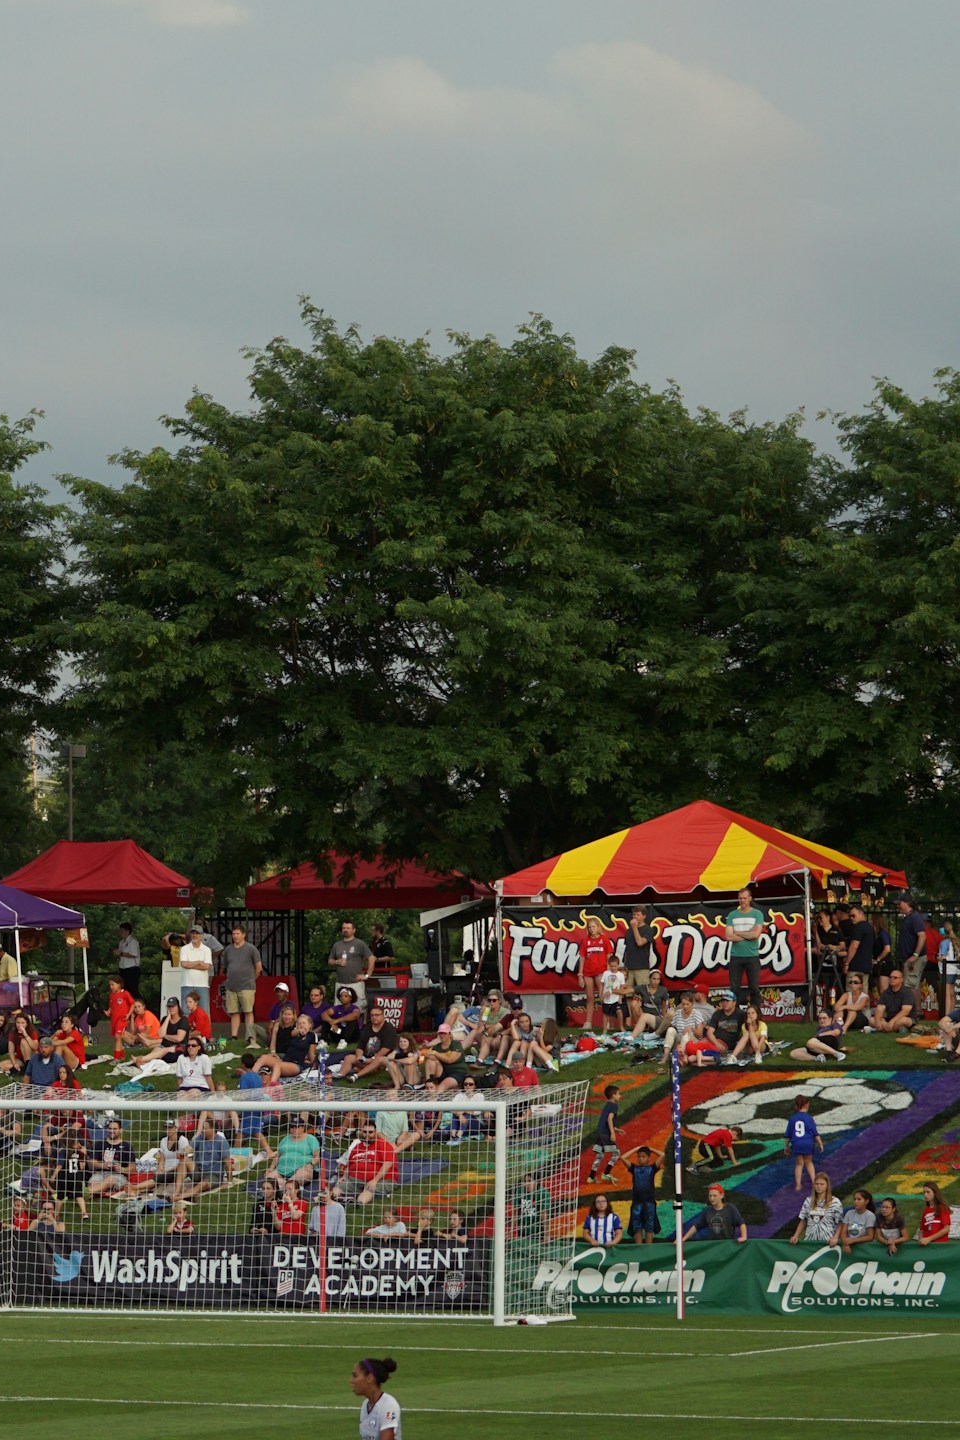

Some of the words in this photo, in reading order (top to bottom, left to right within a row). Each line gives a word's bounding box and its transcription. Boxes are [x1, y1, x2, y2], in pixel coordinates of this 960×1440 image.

[662, 924, 793, 978] Dae's
[377, 998, 402, 1008] DANG
[384, 1009, 401, 1019] OOD
[795, 1120, 805, 1137] 9
[69, 1158, 79, 1174] 13
[91, 1249, 242, 1292] WashSpirit
[766, 1260, 947, 1296] ProChain
[303, 1273, 435, 1297] ACADEMY
[904, 1298, 939, 1308] INC.
